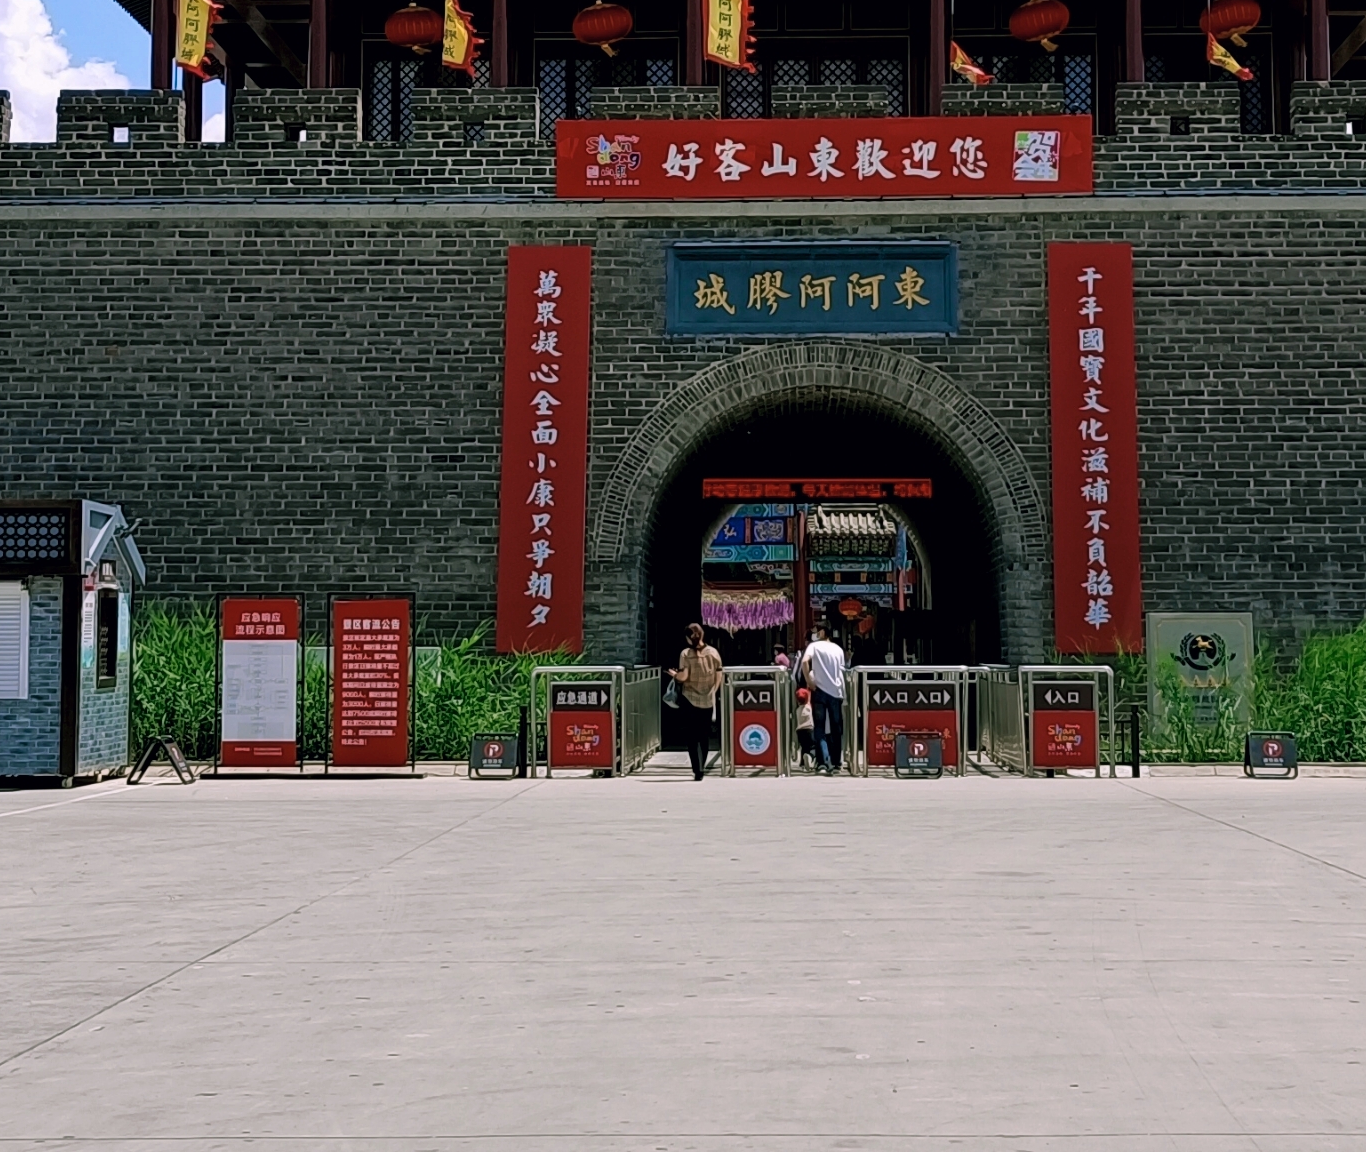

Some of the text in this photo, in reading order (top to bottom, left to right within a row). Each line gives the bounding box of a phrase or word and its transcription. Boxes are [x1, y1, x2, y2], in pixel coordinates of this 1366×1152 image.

[661, 136, 988, 182] 好客山東歡迎您
[693, 265, 931, 317] 東阿阿膠城
[556, 690, 598, 706] 应急通道
[745, 689, 771, 704] 入口
[884, 690, 908, 704] 入口
[915, 690, 941, 704] 入口
[1052, 690, 1079, 704] 入口
